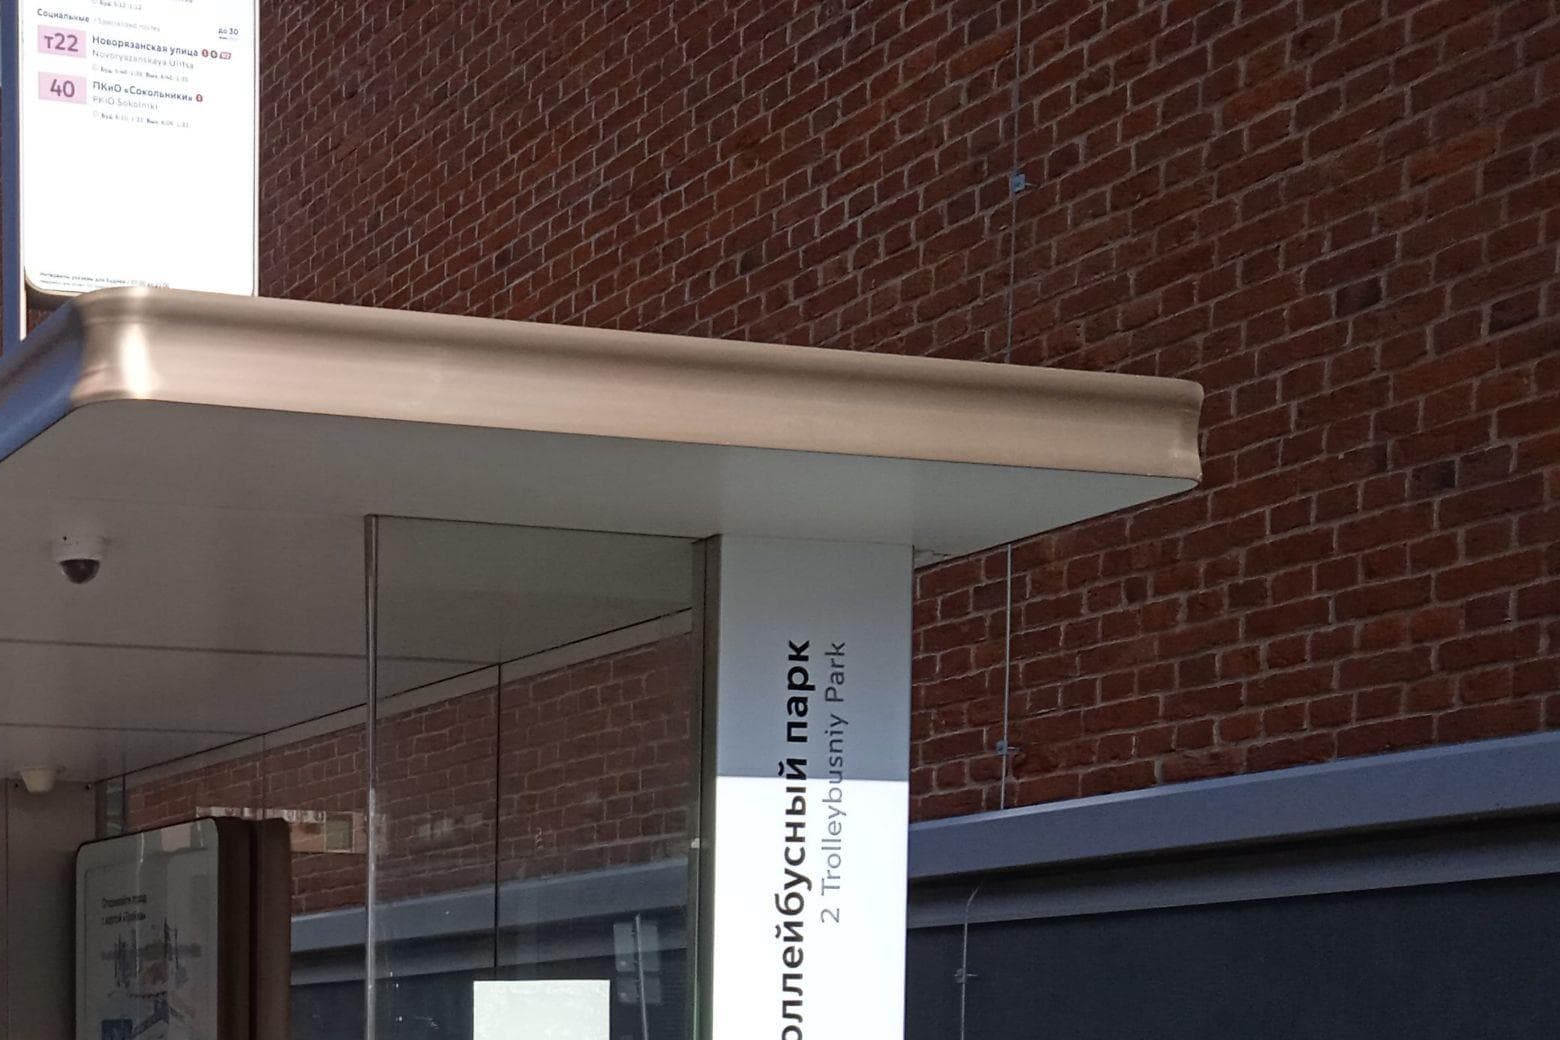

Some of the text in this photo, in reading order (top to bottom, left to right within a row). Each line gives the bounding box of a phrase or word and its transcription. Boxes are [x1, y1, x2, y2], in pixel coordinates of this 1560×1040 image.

[92, 35, 199, 56] Новорязанская улица
[49, 78, 76, 98] 40
[93, 80, 121, 93] ПКиО
[786, 640, 817, 743] парк
[820, 642, 849, 924] 2 Trolleybusniy Park
